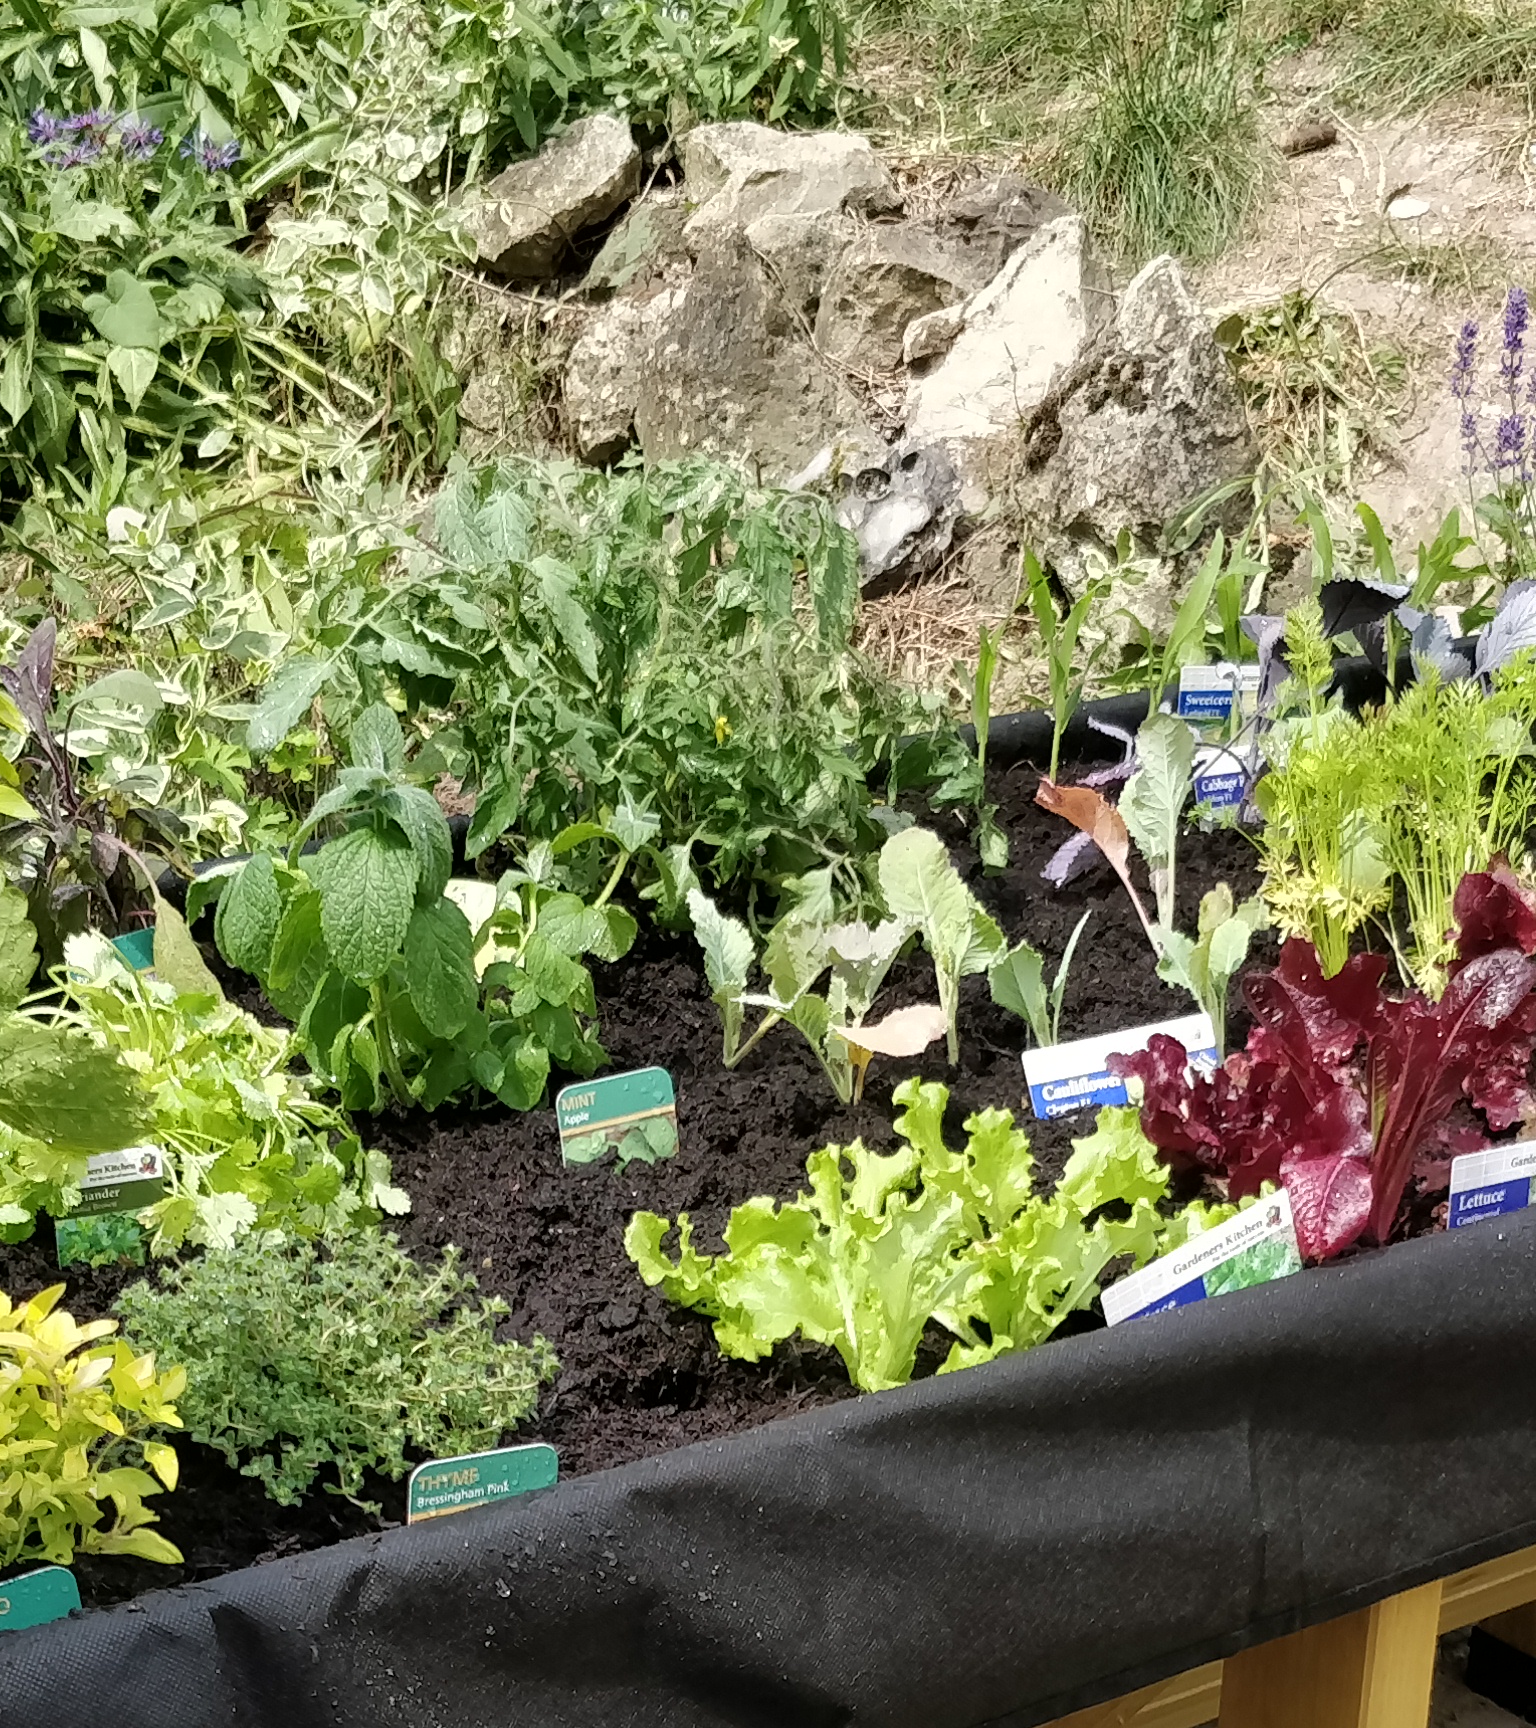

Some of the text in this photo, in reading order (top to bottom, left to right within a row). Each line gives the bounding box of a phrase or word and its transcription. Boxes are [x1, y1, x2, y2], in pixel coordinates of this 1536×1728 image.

[562, 1091, 596, 1111] MINT
[564, 1112, 589, 1126] Apple
[104, 1163, 136, 1175] Kitchen
[82, 1188, 120, 1202] riander
[1459, 1189, 1507, 1211] Lettuce
[1173, 1242, 1224, 1276] Gardeners
[1225, 1220, 1263, 1247] Kitchen
[418, 1467, 480, 1492] THYME
[417, 1480, 510, 1509] Bressingham Pink
